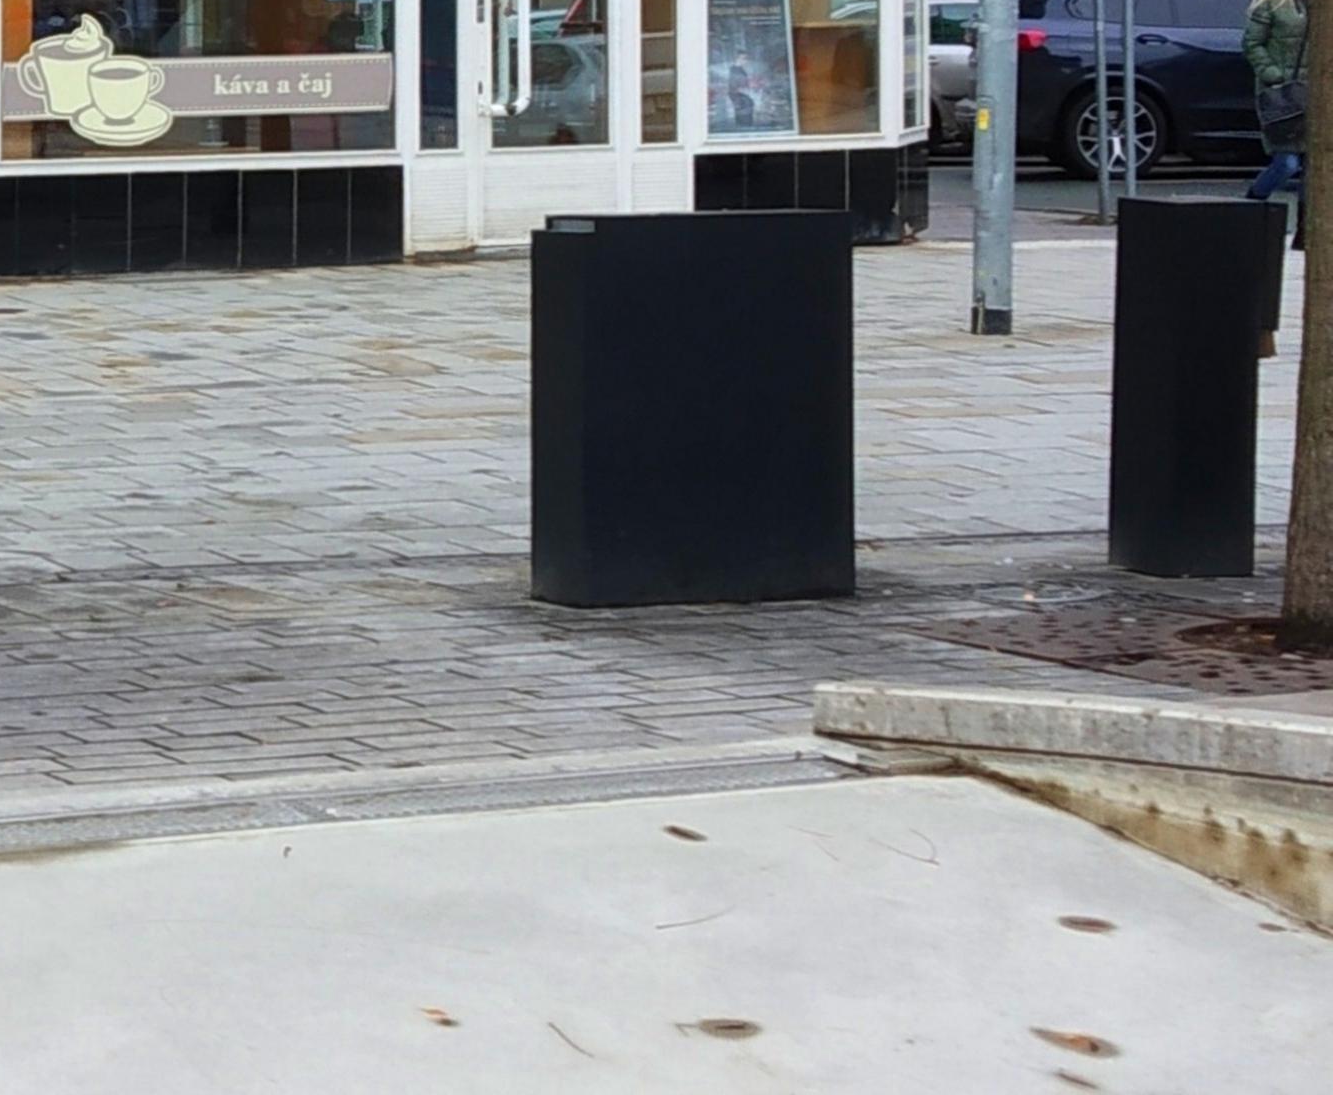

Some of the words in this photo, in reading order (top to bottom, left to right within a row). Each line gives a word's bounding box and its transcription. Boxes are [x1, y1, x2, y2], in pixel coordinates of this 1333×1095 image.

[213, 73, 269, 95] káva
[277, 79, 291, 94] a
[298, 72, 332, 98] čaj
